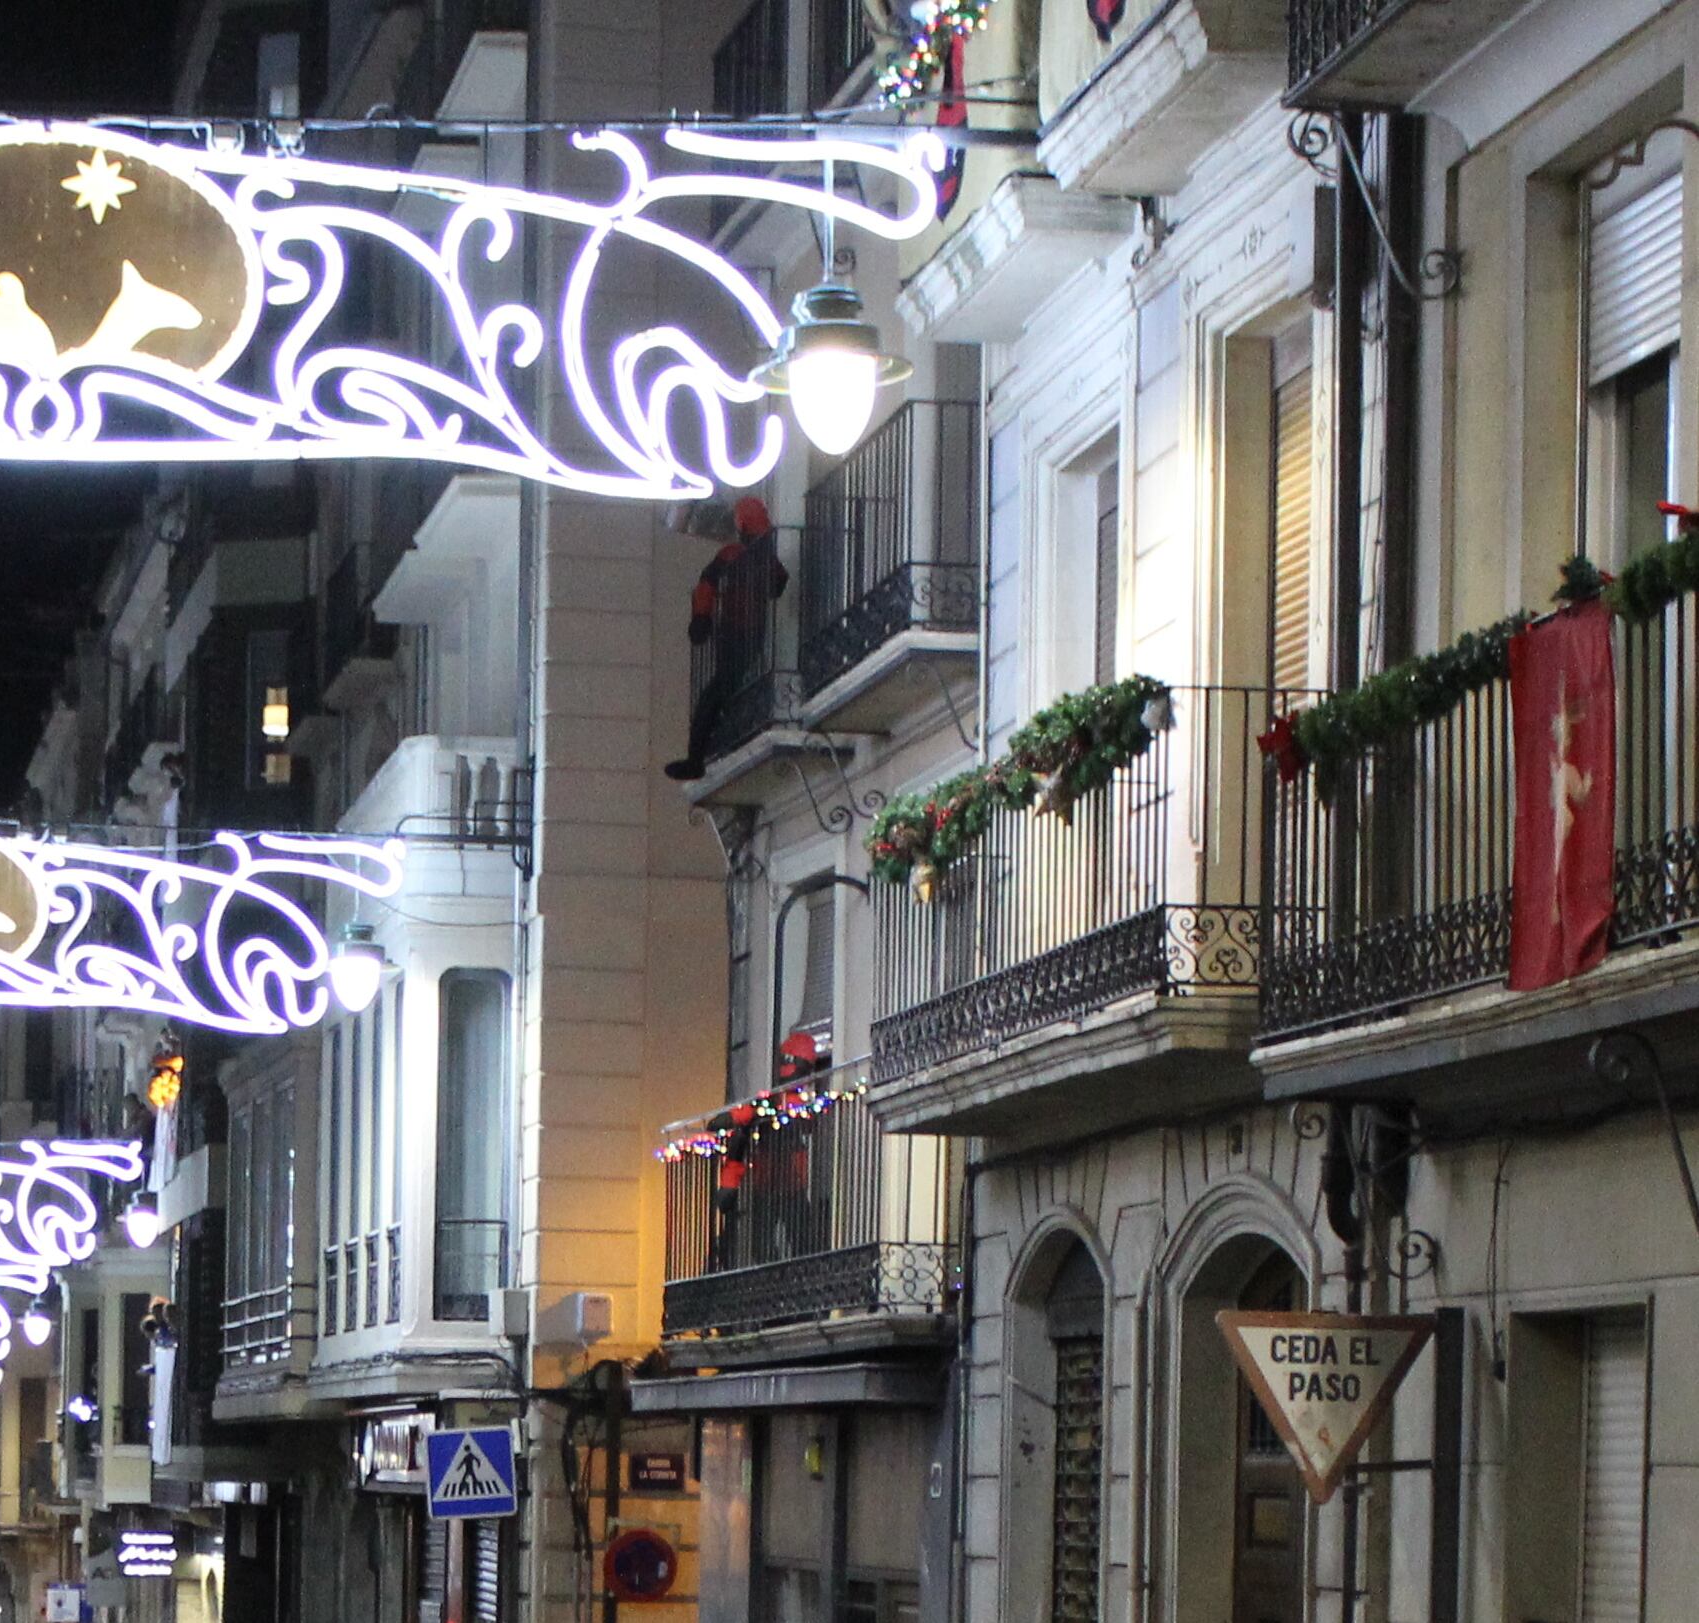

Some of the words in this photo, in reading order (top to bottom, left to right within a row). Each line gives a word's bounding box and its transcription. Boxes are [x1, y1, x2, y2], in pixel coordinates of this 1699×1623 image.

[1270, 1334, 1338, 1365] CEDA
[1350, 1336, 1381, 1366] EL
[1289, 1372, 1361, 1402] PASO
